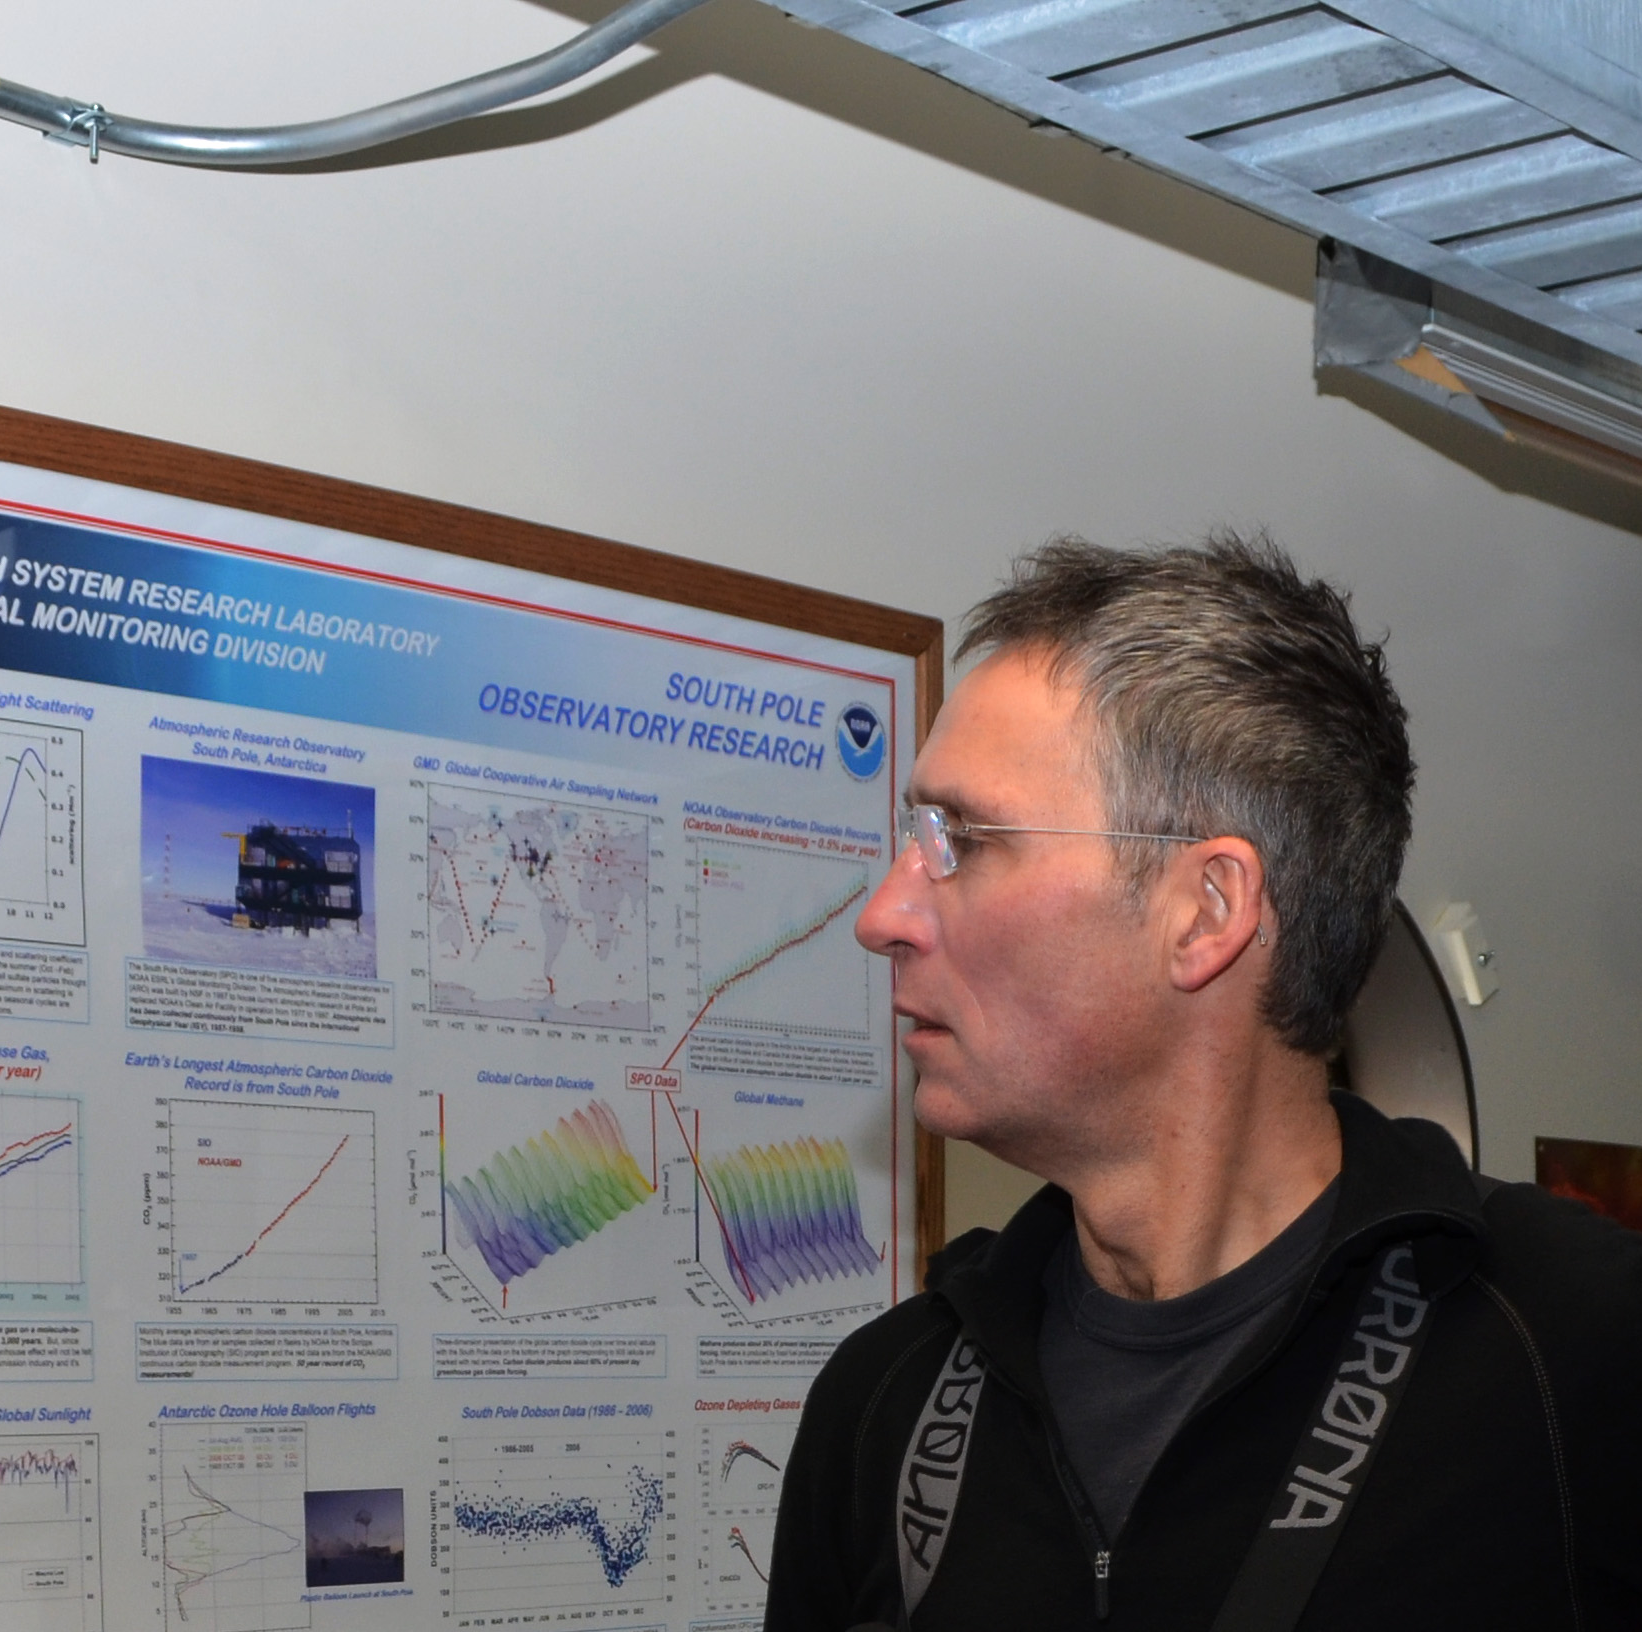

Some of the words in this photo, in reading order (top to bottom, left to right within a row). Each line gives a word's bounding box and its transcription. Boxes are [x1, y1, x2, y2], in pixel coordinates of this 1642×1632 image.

[11, 558, 124, 604] SYSTEM
[129, 579, 269, 624] RESEARCH
[275, 605, 441, 658] LABORATORY
[32, 602, 209, 655] MONITORING
[214, 632, 328, 675] DIVISION
[25, 695, 94, 721] Scattering
[666, 673, 755, 714] SOUTH
[760, 692, 824, 728] POLE
[150, 716, 230, 740] Atmospheric
[233, 728, 291, 749] Research
[294, 738, 366, 762] Observatory
[479, 685, 685, 743] OBSERVATORY
[689, 721, 825, 769] RESEARCH
[192, 742, 228, 759] South
[231, 748, 260, 766] Pole,
[264, 753, 326, 774] Antarctica
[413, 759, 440, 771] GMD
[445, 763, 481, 777] Global
[483, 769, 547, 788] Cooperative
[549, 778, 564, 790] Air
[567, 780, 614, 801] Sampling
[616, 788, 658, 805] Network
[684, 801, 713, 816] NOAA
[715, 806, 773, 827] Observatory
[775, 815, 808, 831] Carbon
[810, 821, 843, 837] Dioxide
[845, 827, 881, 843] Records
[21, 1045, 49, 1062] Gas,
[6, 1065, 42, 1081] year)
[125, 1052, 171, 1069] Earth's
[174, 1057, 224, 1074] Longest
[226, 1060, 303, 1077] Atmospheric
[306, 1065, 349, 1080] Carbon
[351, 1069, 393, 1084] Dioxide
[477, 1070, 512, 1085] Global
[514, 1073, 553, 1088] Carbon
[555, 1076, 594, 1091] Dioxide
[630, 1072, 653, 1086] SPO
[655, 1074, 678, 1088] Data
[185, 1076, 232, 1092] Record
[233, 1080, 244, 1093] is
[247, 1080, 275, 1094] from
[278, 1082, 312, 1097] South
[315, 1085, 340, 1099] Pole
[735, 1090, 765, 1104] Global
[766, 1093, 804, 1108] Methane
[38, 1407, 91, 1425] Sunlight
[159, 1406, 216, 1418] Antarctic
[219, 1405, 258, 1418] Ozone
[261, 1404, 288, 1417] Hole
[291, 1403, 335, 1417] Balloon
[337, 1403, 376, 1419] Flights
[462, 1407, 493, 1419] South
[495, 1406, 519, 1418] Pole
[521, 1405, 560, 1418] Dobson
[563, 1405, 586, 1418] Data
[588, 1404, 617, 1419] (1986
[625, 1403, 653, 1418] 2006)
[694, 1399, 725, 1411] Ozone
[727, 1399, 771, 1413] Depleting
[773, 1398, 800, 1410] Gases
[430, 1523, 438, 1568] DOBSON
